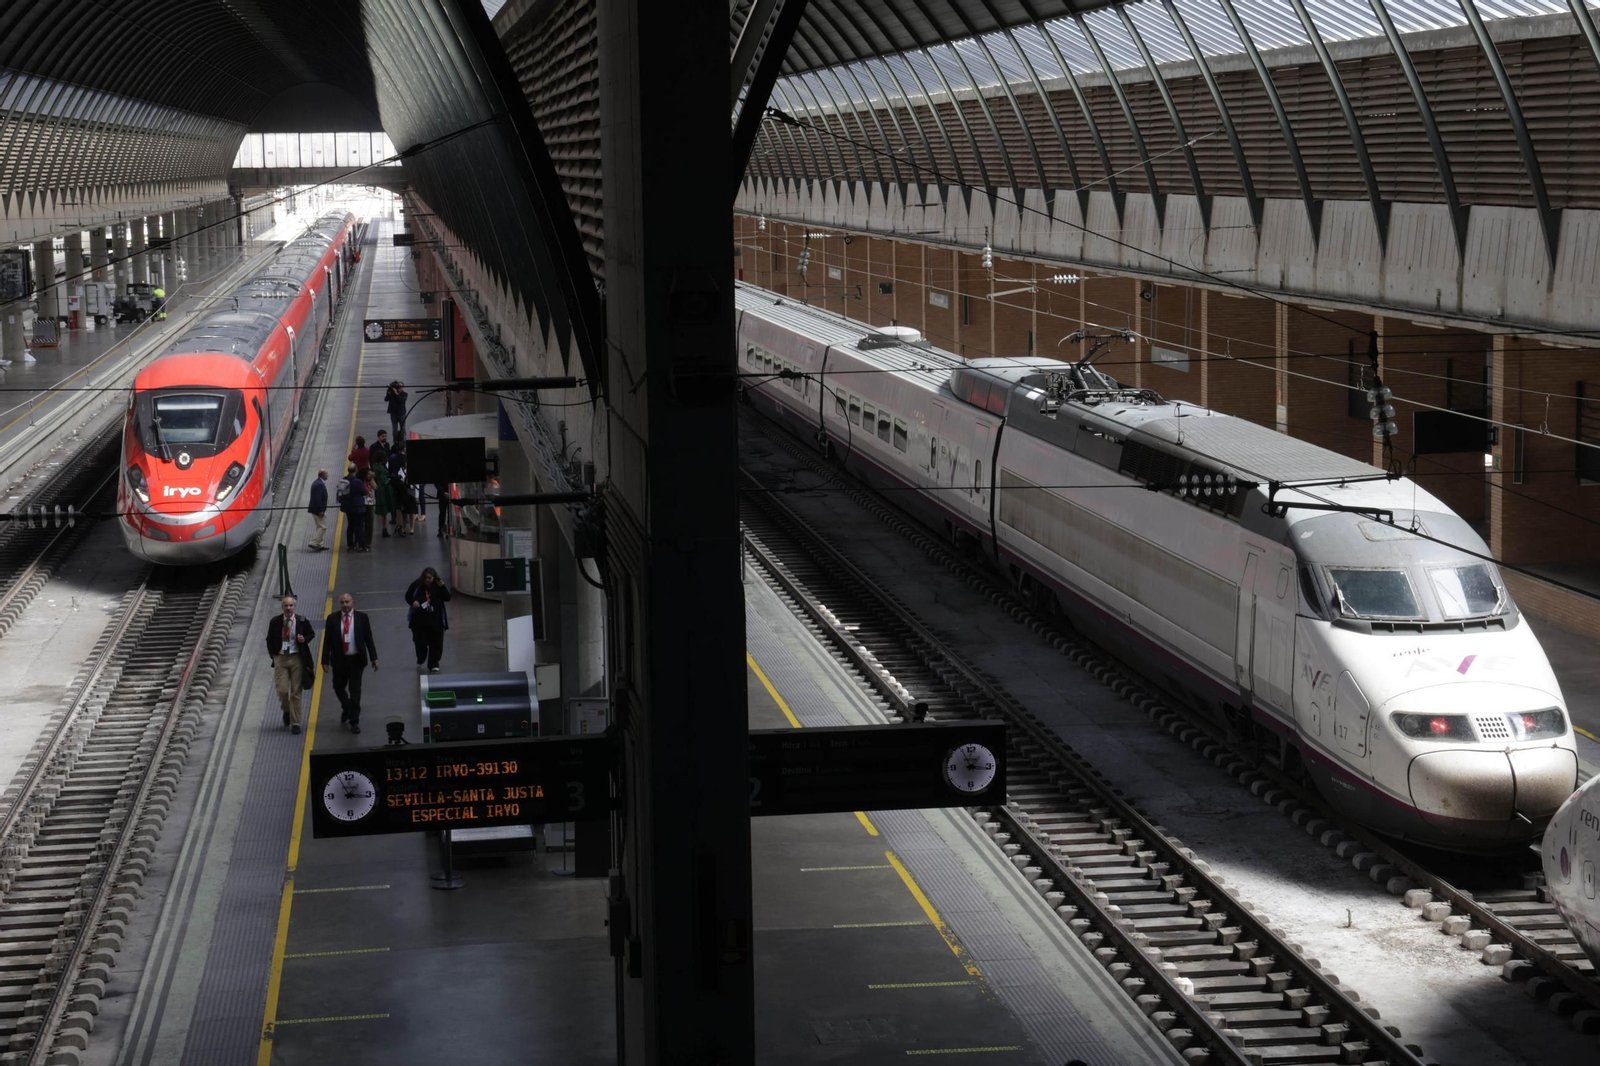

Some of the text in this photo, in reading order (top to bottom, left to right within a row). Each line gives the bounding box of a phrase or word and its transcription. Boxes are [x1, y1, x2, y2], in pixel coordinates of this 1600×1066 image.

[433, 329, 440, 339] 3
[163, 485, 202, 498] iryo
[485, 575, 495, 590] 3
[1301, 664, 1332, 691] AVE
[1339, 725, 1348, 740] 17
[385, 766, 428, 781] 13:12
[435, 760, 518, 778] IRYO-39130
[386, 784, 544, 807] SEVILLA-SANTA JUSTA
[566, 781, 585, 811] 3
[748, 776, 762, 807] 2
[411, 803, 520, 823] ESPECIAL IRYO
